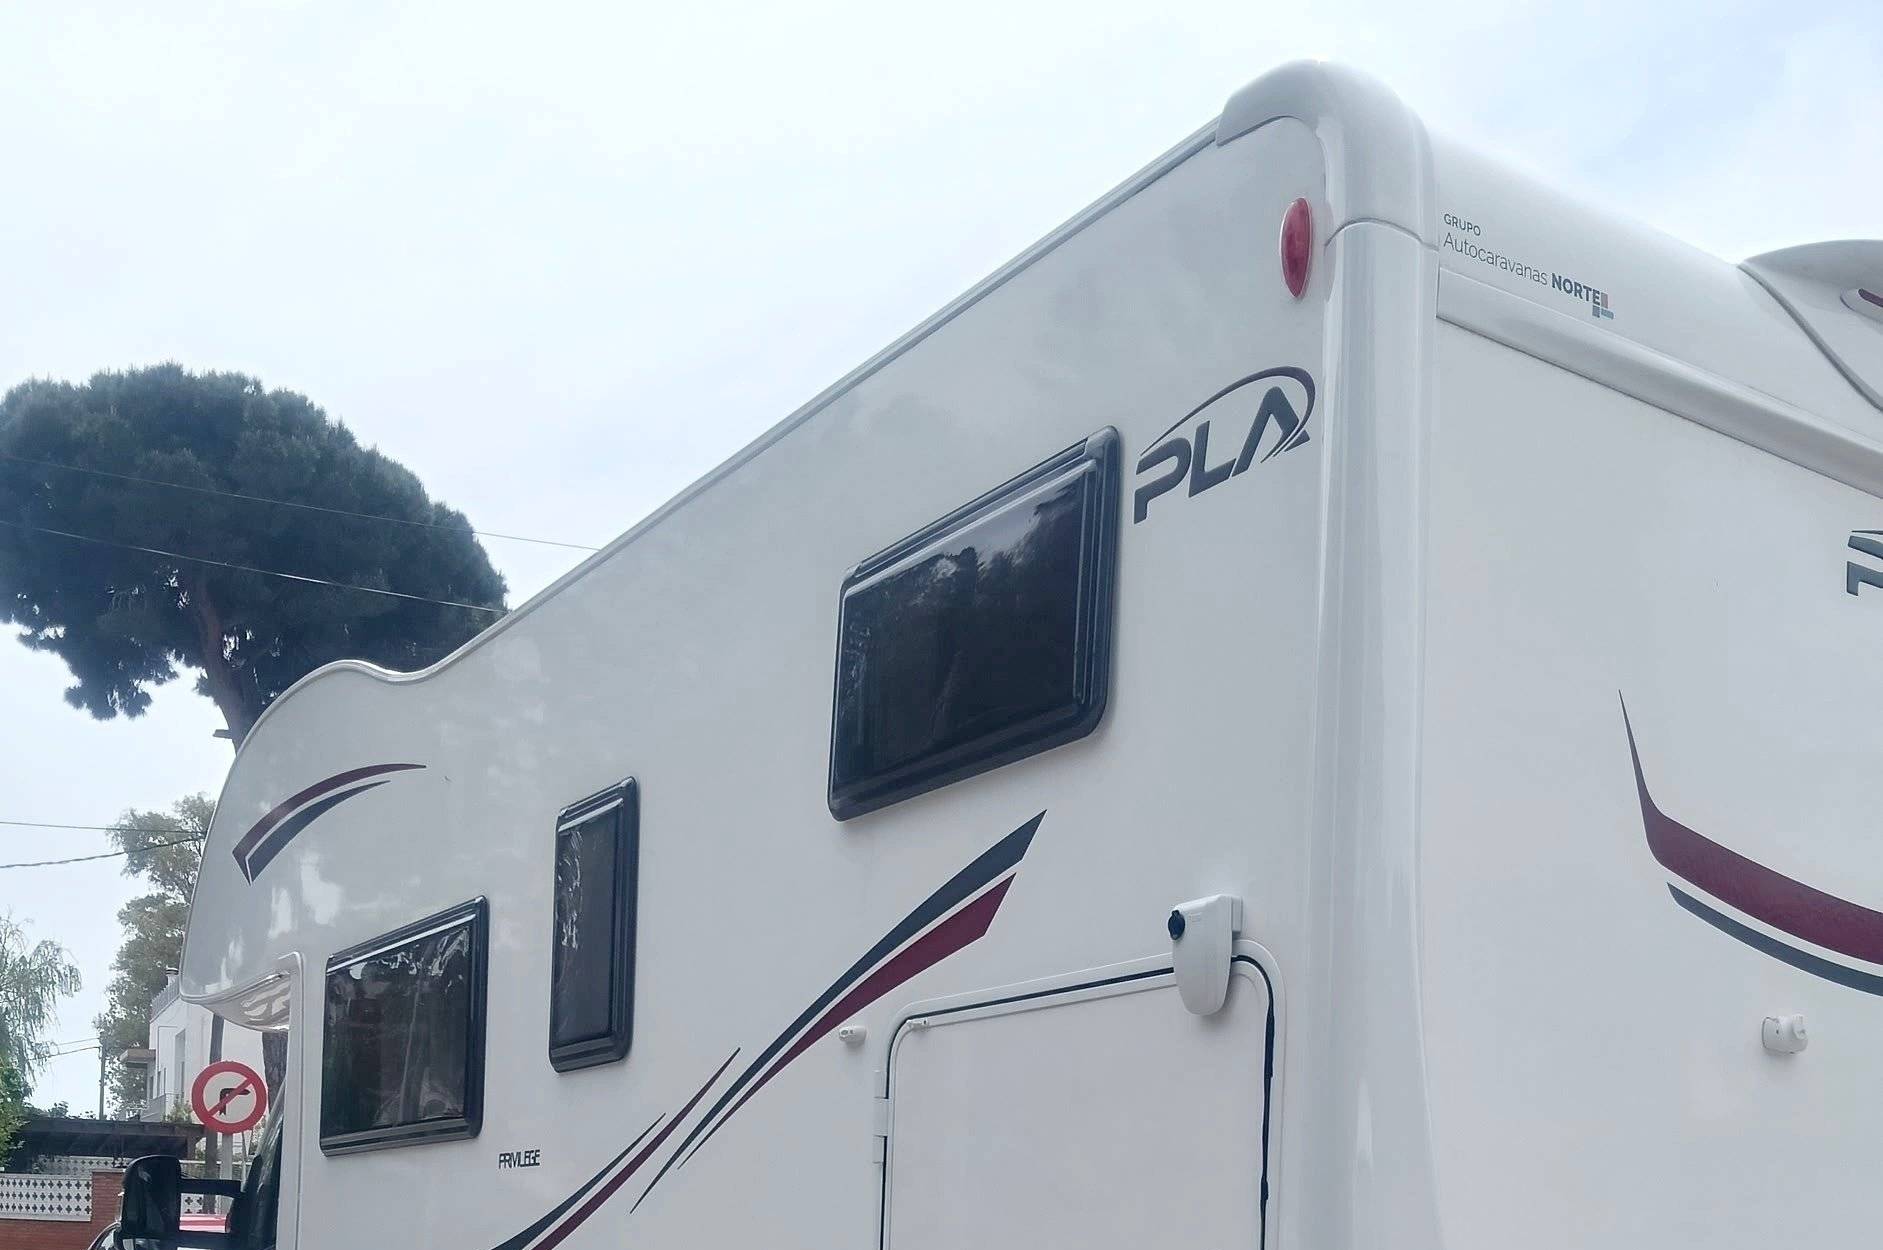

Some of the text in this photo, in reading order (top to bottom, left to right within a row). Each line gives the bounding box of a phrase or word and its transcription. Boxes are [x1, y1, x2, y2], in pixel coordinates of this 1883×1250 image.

[1443, 213, 1482, 237] GRUPO
[1443, 232, 1601, 306] Autocaravanas NORTE
[1133, 385, 1311, 525] PLA
[498, 1149, 541, 1169] PRIVILEGE
